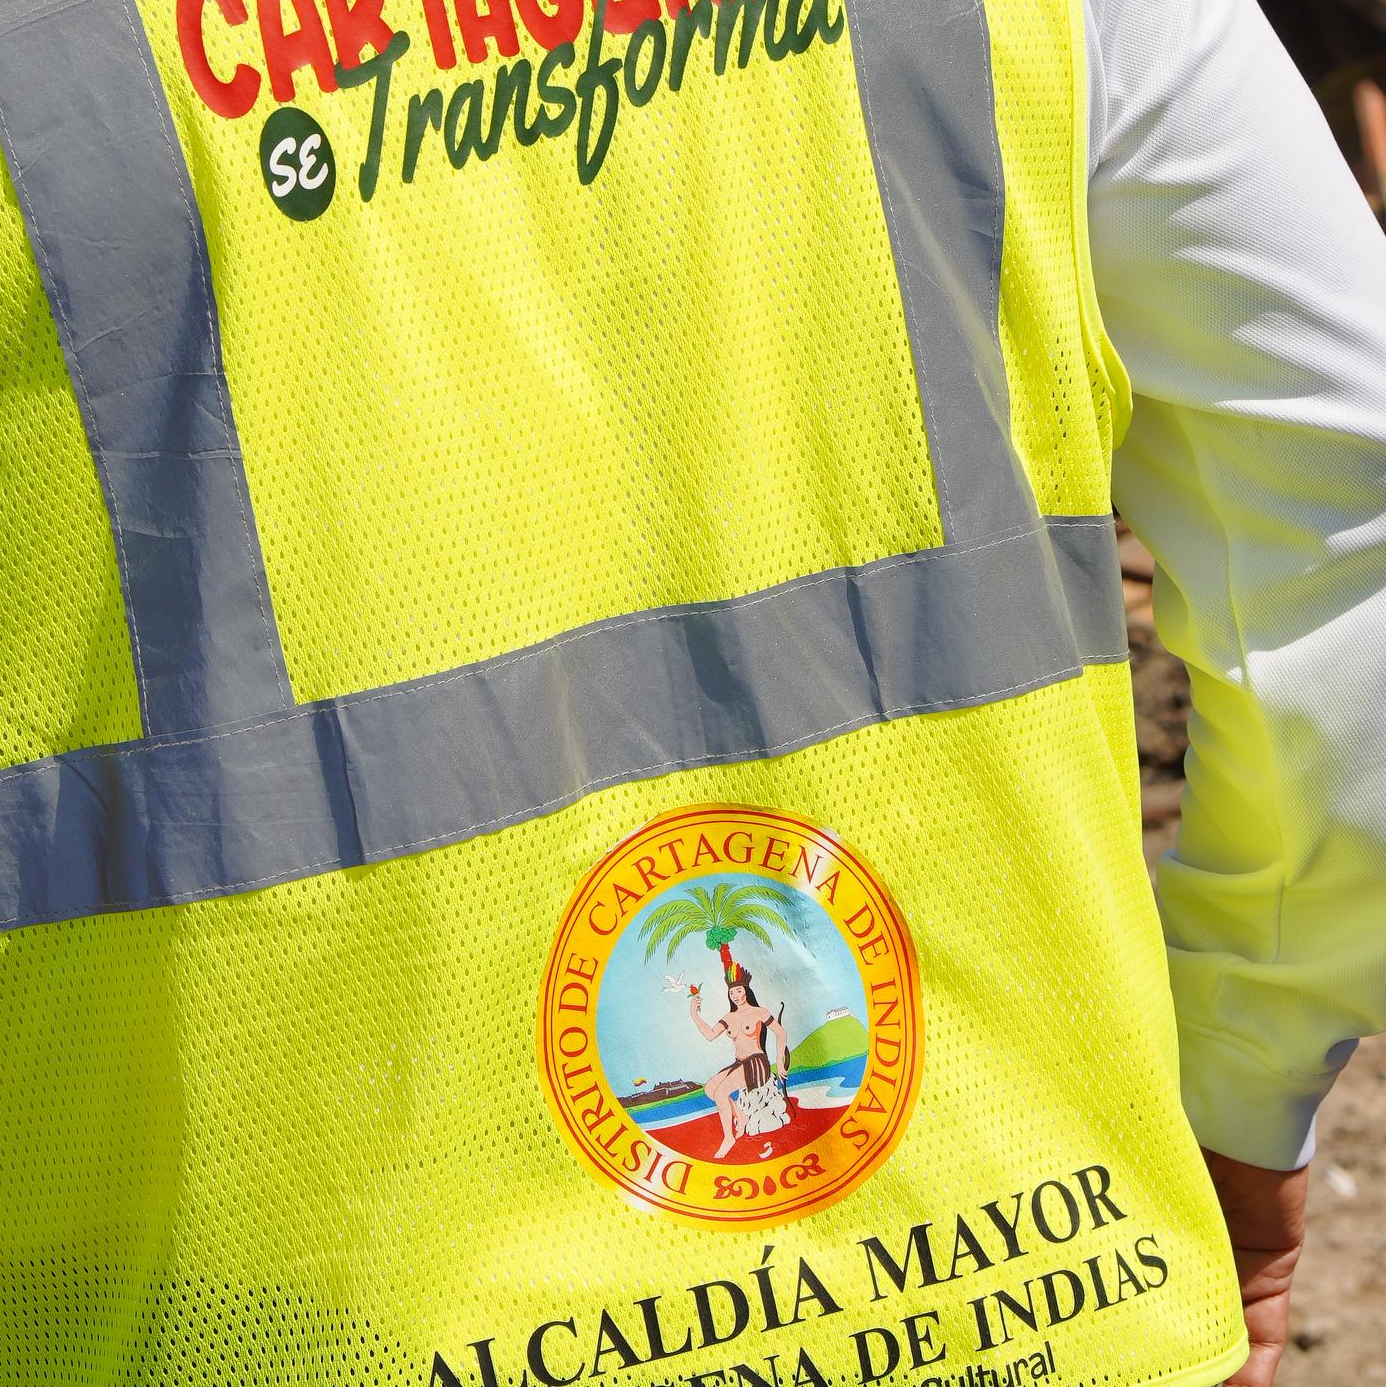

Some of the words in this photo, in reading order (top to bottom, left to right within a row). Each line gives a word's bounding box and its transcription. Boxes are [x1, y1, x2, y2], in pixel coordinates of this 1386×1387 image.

[588, 831, 844, 936] CARTAGENA
[843, 901, 890, 966] DE
[557, 952, 599, 1016] DE
[558, 1026, 694, 1196] DISTRITO
[840, 979, 901, 1152] INDIAS
[857, 1162, 1128, 1301] MAYOR
[849, 1311, 947, 1386] DE
[967, 1234, 1169, 1352] INDIAS
